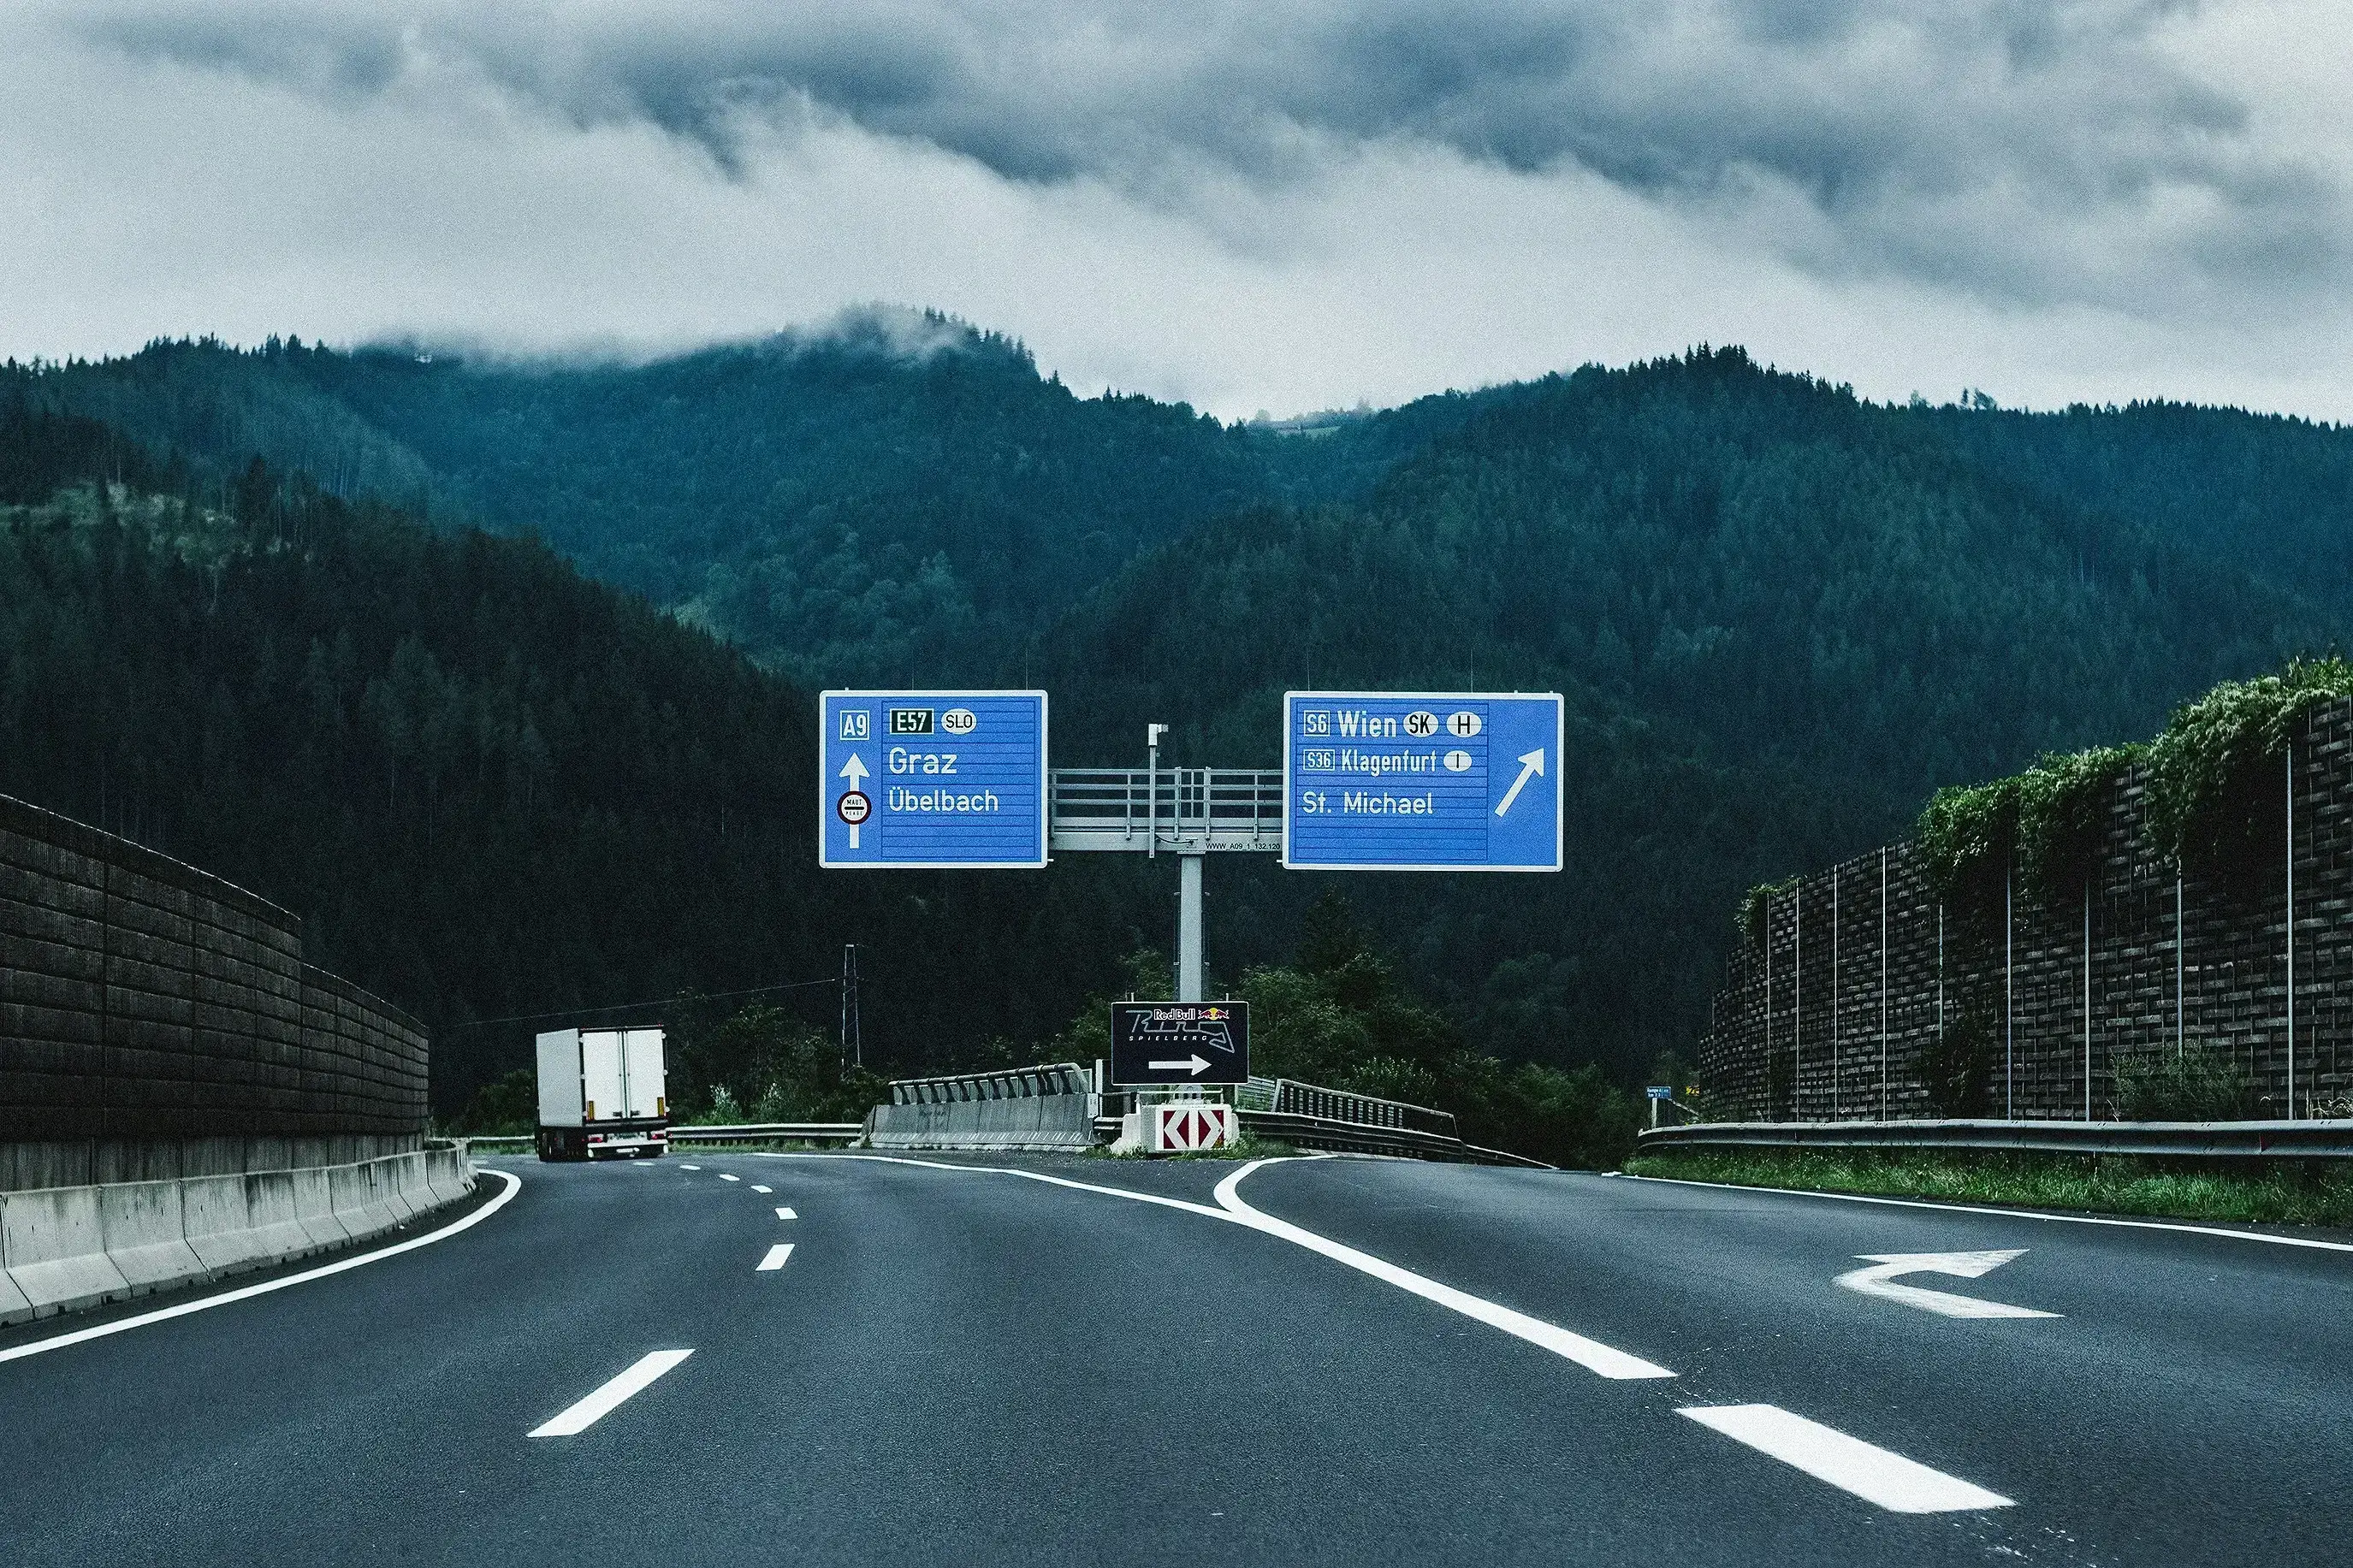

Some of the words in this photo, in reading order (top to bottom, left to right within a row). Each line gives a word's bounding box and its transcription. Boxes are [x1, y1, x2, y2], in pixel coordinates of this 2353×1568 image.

[843, 713, 867, 737] A9
[897, 712, 928, 731] E57
[945, 714, 973, 729] SLO
[1307, 714, 1327, 734] S6
[1337, 710, 1396, 737] Wien
[1408, 715, 1431, 733] SK
[1457, 715, 1471, 734] H
[889, 747, 957, 774] Graz
[1307, 754, 1331, 768] S36
[1341, 749, 1437, 777] Klagenfurt
[1455, 753, 1460, 768] I
[889, 786, 999, 812] Übelbach
[1302, 791, 1331, 814] St.
[1343, 791, 1433, 814] Michael
[1153, 1009, 1174, 1020] Red
[1176, 1009, 1195, 1020] Bull
